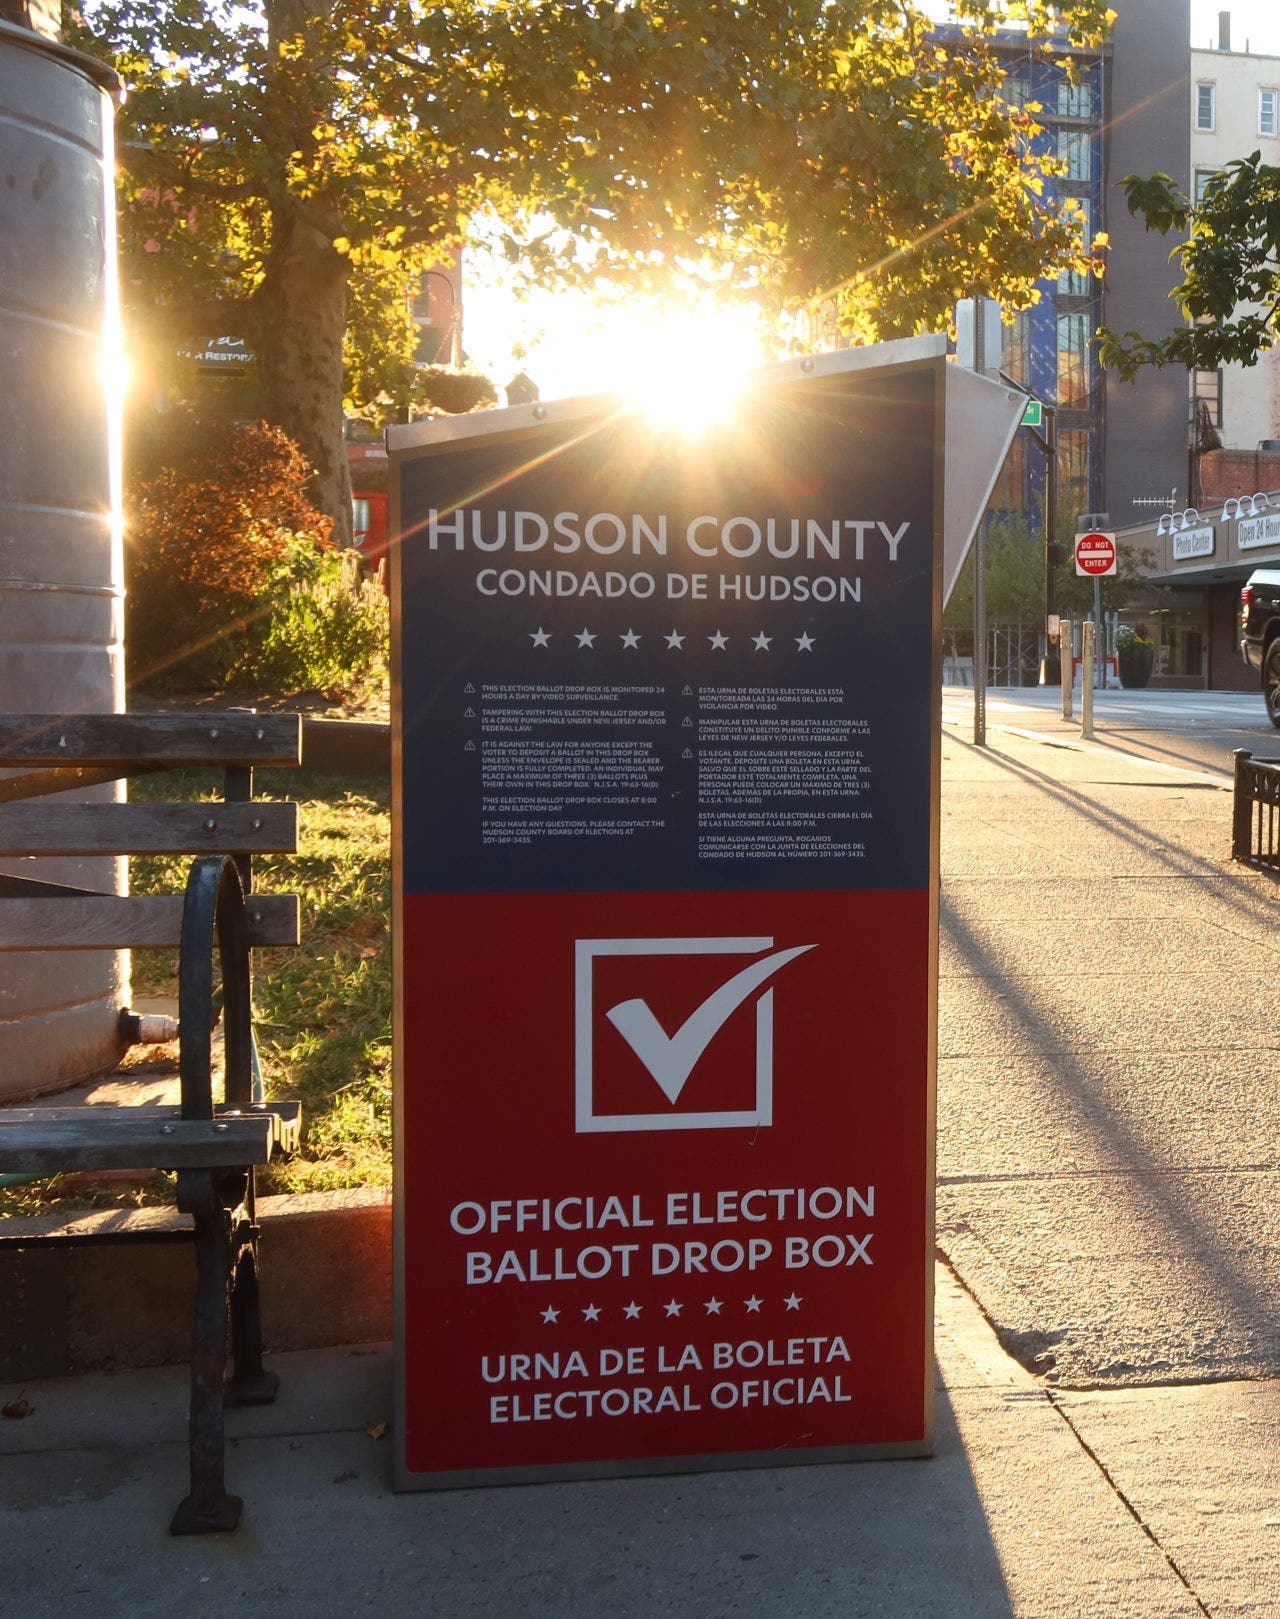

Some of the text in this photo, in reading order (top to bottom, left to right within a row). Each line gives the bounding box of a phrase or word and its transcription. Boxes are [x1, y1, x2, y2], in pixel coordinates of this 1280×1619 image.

[428, 509, 911, 562] HUDSON COUNTY
[1095, 541, 1109, 549] NOT
[1176, 533, 1210, 553] Photo Center
[1239, 522, 1254, 546] Open
[1255, 521, 1265, 539] 24
[1084, 559, 1107, 567] ENTER
[476, 568, 862, 603] CONDADO DE HUDSON
[450, 1186, 876, 1236] OFFICIAL ELECTION
[466, 1234, 875, 1285] BALLOT DROP BOX
[481, 1336, 852, 1384] URNA DE LA BOLETA
[490, 1375, 852, 1424] ELECTORAL OFICIAL
